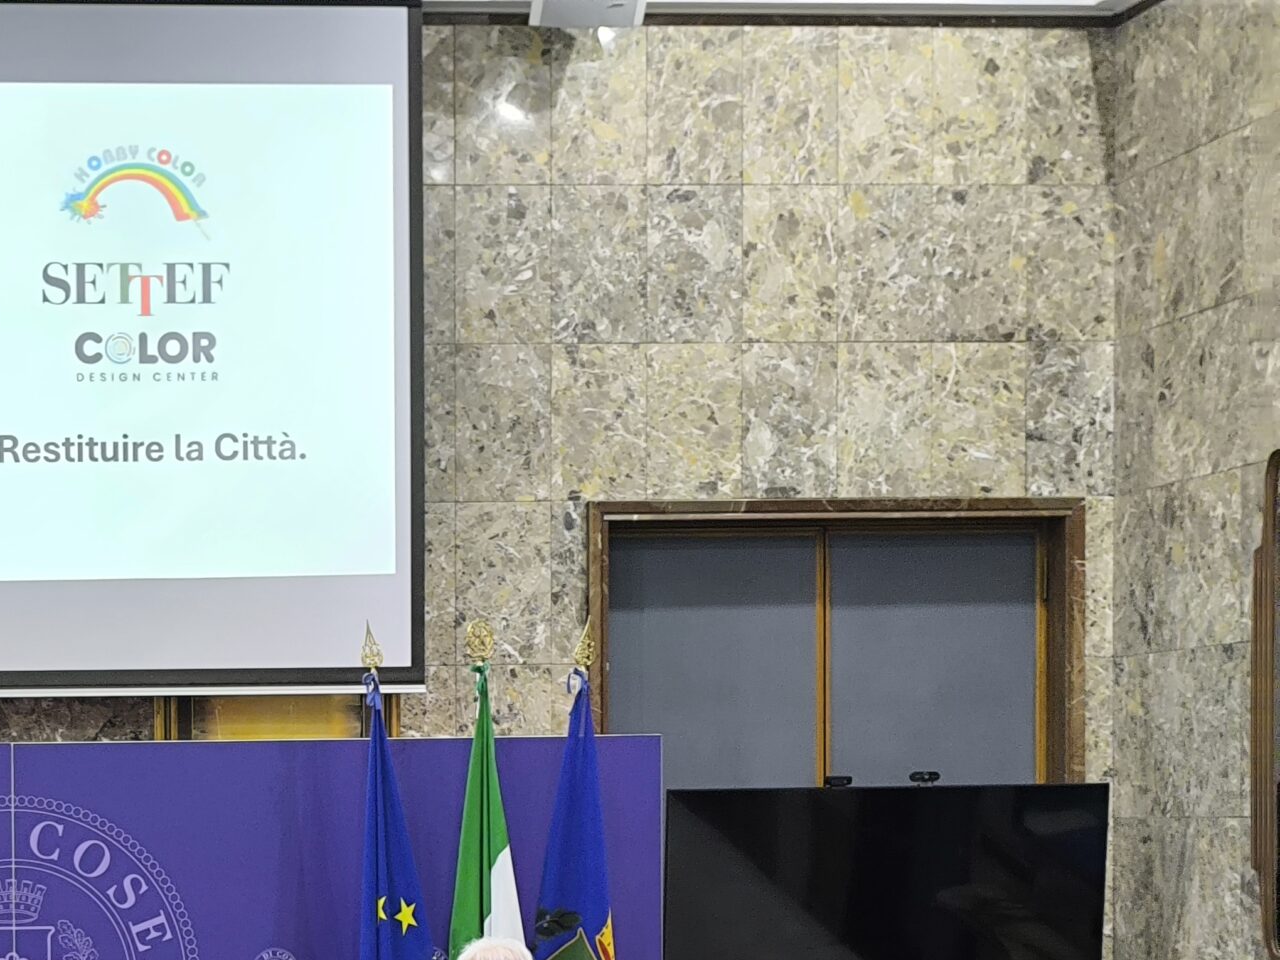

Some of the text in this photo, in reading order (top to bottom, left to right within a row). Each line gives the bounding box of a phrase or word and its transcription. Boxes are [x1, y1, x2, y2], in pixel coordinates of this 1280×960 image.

[73, 145, 207, 188] HOBBY COLOR
[41, 261, 230, 316] SETTEF
[74, 331, 217, 364] COLOR
[76, 371, 219, 382] DESIGN CENTER
[174, 433, 204, 461] la
[214, 431, 307, 461] Città.
